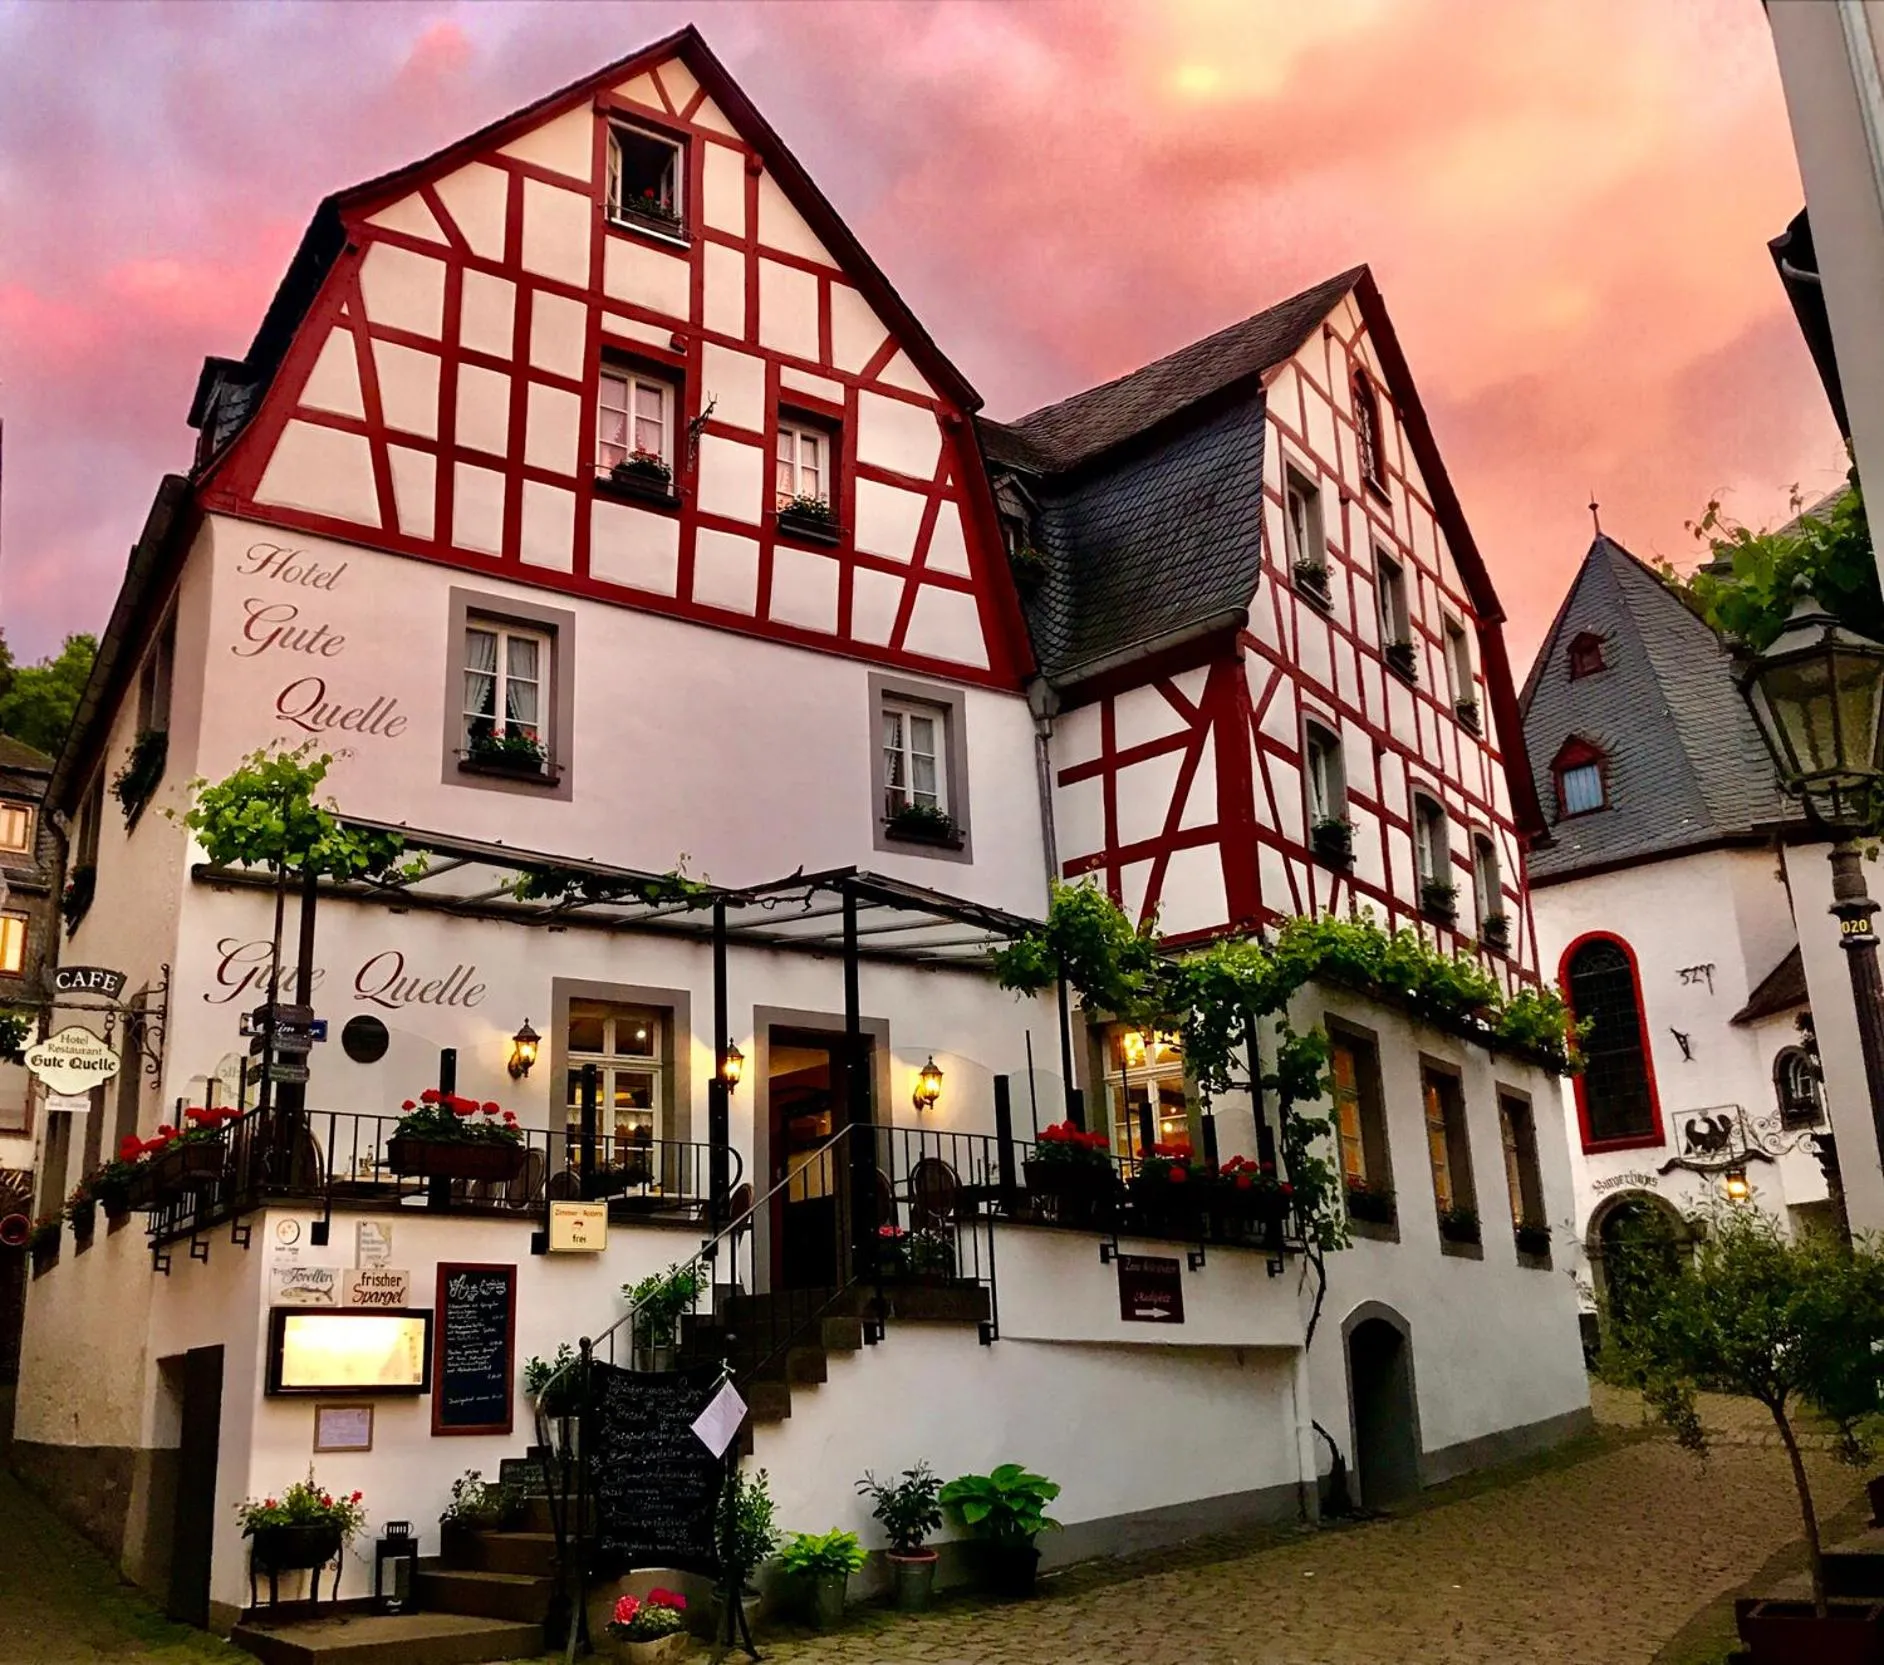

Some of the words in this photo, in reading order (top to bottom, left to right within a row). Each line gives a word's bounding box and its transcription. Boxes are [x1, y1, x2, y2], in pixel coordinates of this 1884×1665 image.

[237, 543, 348, 591] Hotel
[231, 598, 346, 657] Gute
[275, 677, 408, 738] Quelle
[1841, 919, 1868, 934] 020
[56, 971, 118, 992] CAFE
[354, 951, 487, 1009] Quelle
[47, 1043, 103, 1056] Restaurant
[60, 1033, 89, 1045] Hotel
[30, 1054, 65, 1069] Gute
[69, 1057, 116, 1072] Quelle
[361, 1271, 403, 1287] frischer
[352, 1282, 407, 1306] Spargel
